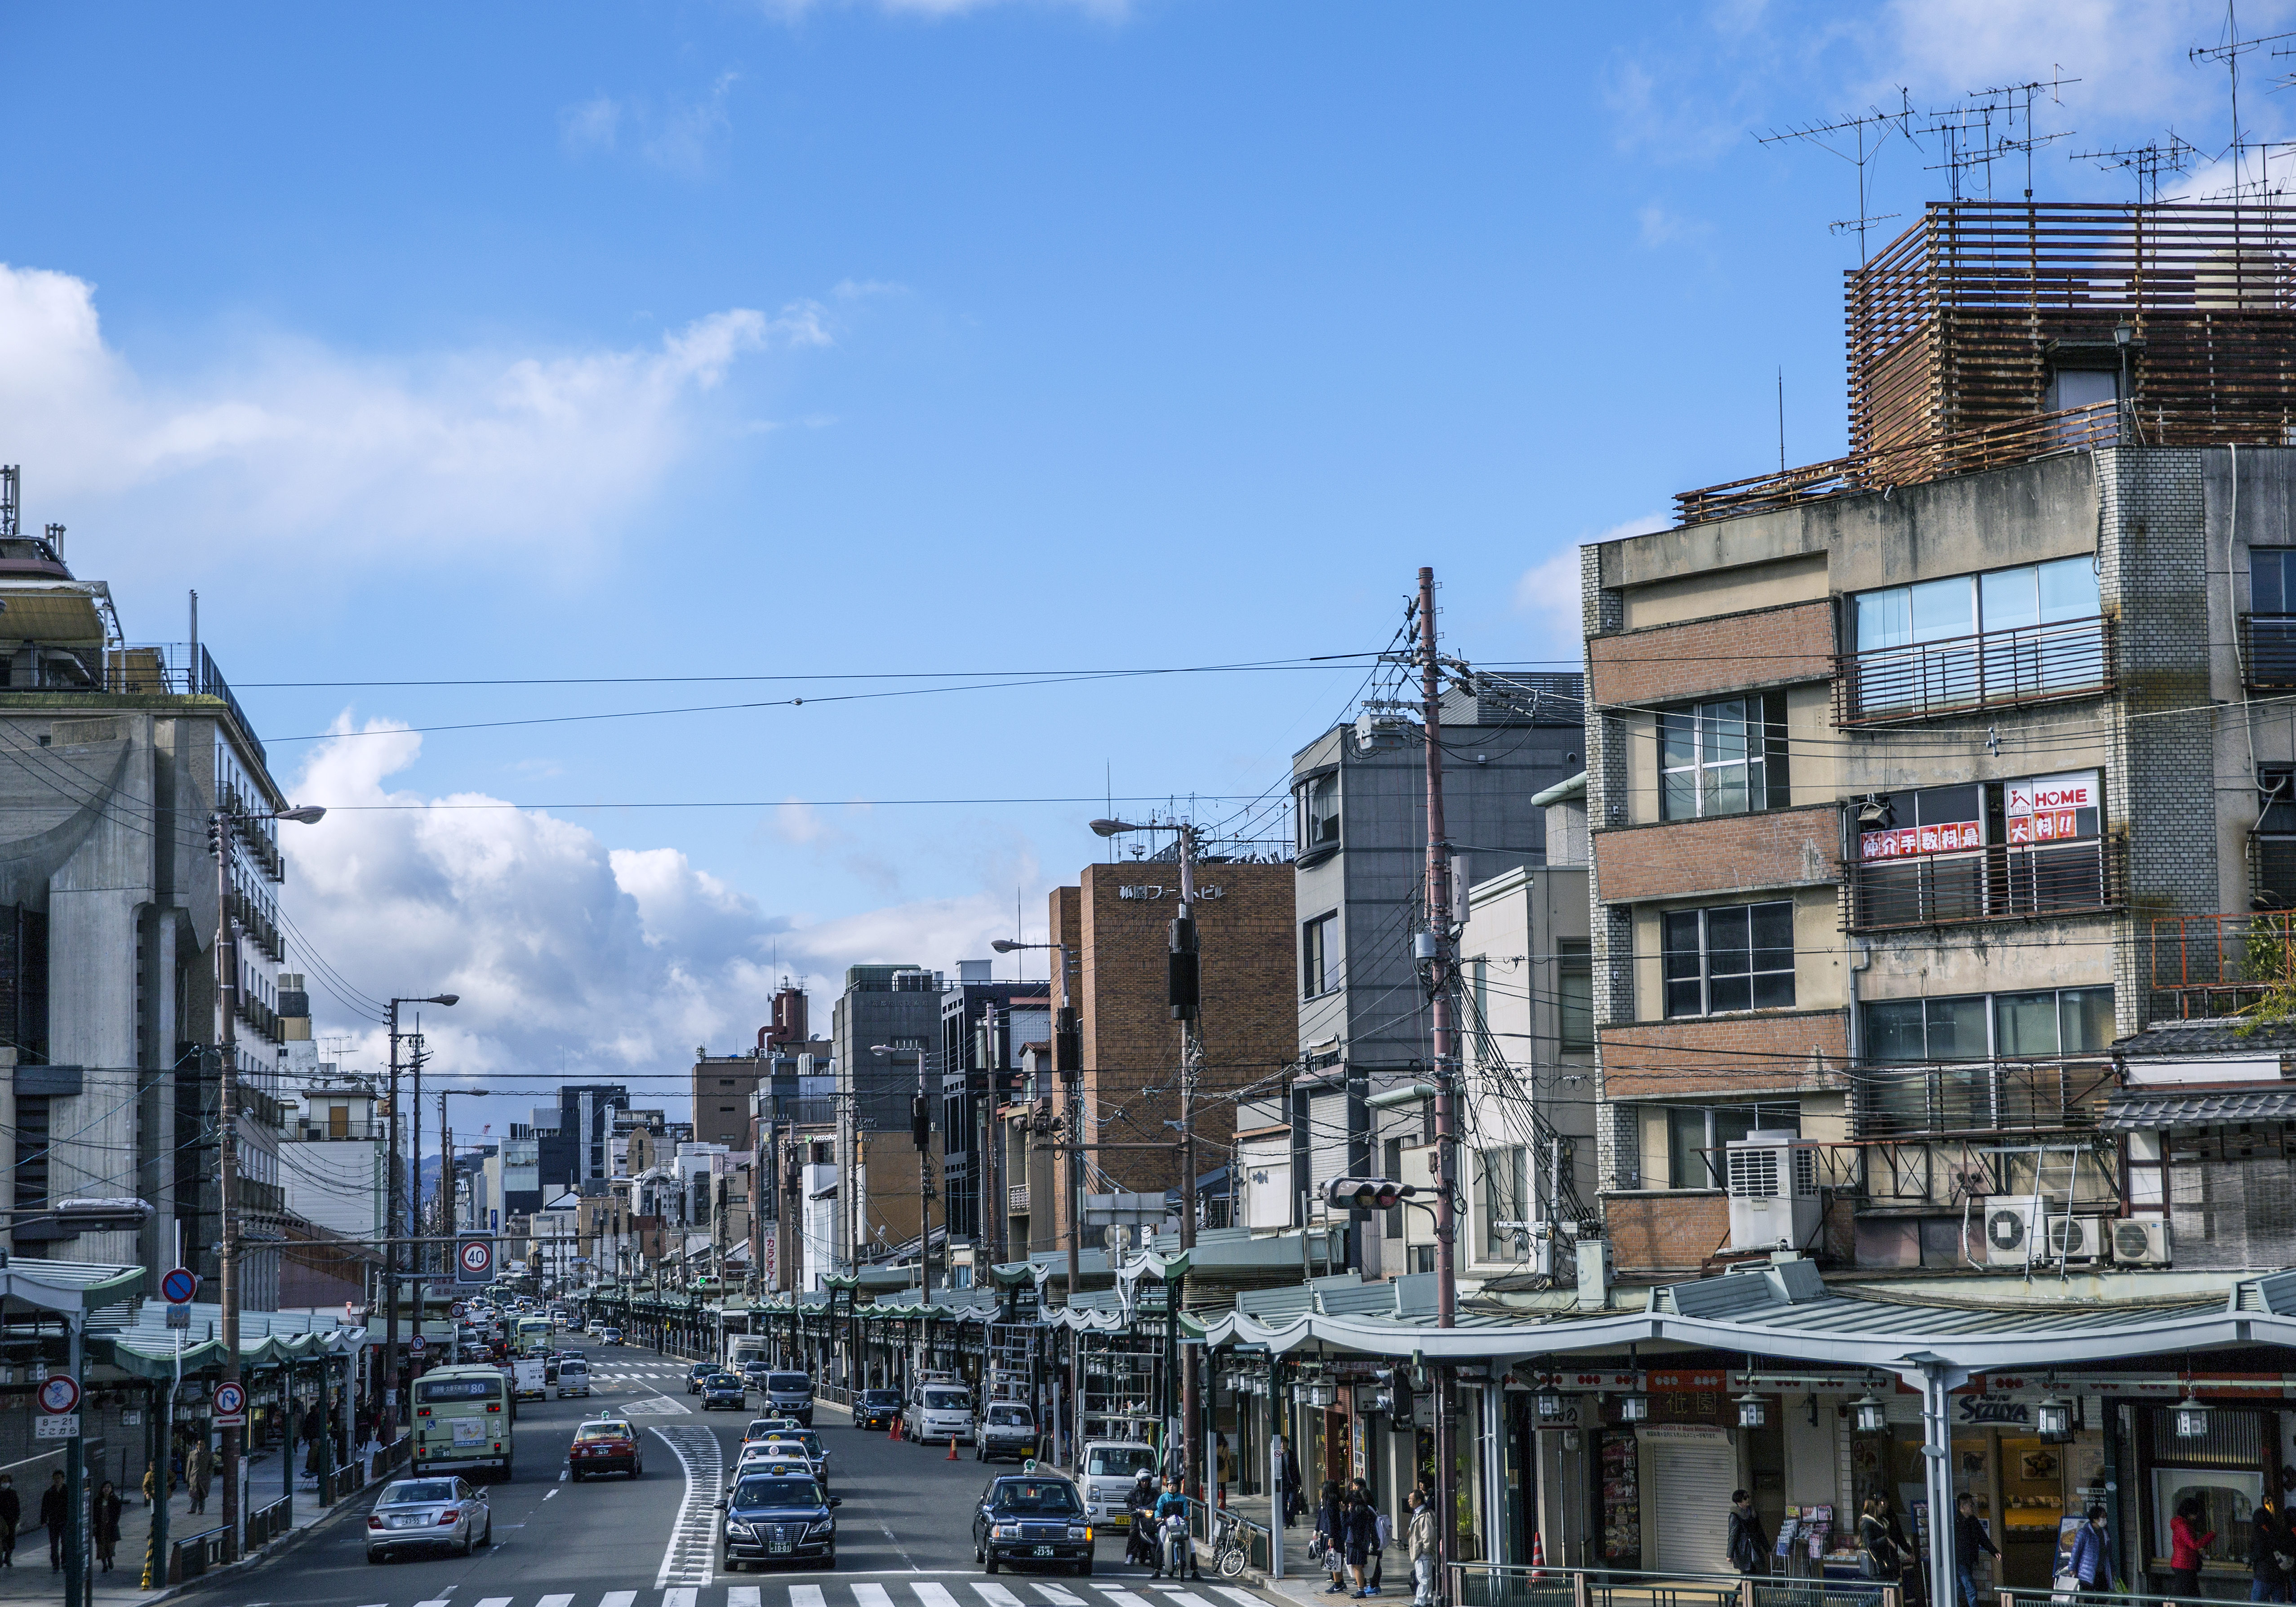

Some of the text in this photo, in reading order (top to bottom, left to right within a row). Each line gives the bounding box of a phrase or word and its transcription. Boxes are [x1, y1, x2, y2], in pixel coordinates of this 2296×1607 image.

[2035, 788, 2087, 806] HOME
[812, 1133, 837, 1143] yasaka
[467, 1250, 484, 1264] 40
[766, 1238, 775, 1278] カラオケ
[470, 1384, 485, 1393] 80
[39, 1427, 77, 1436] ここから
